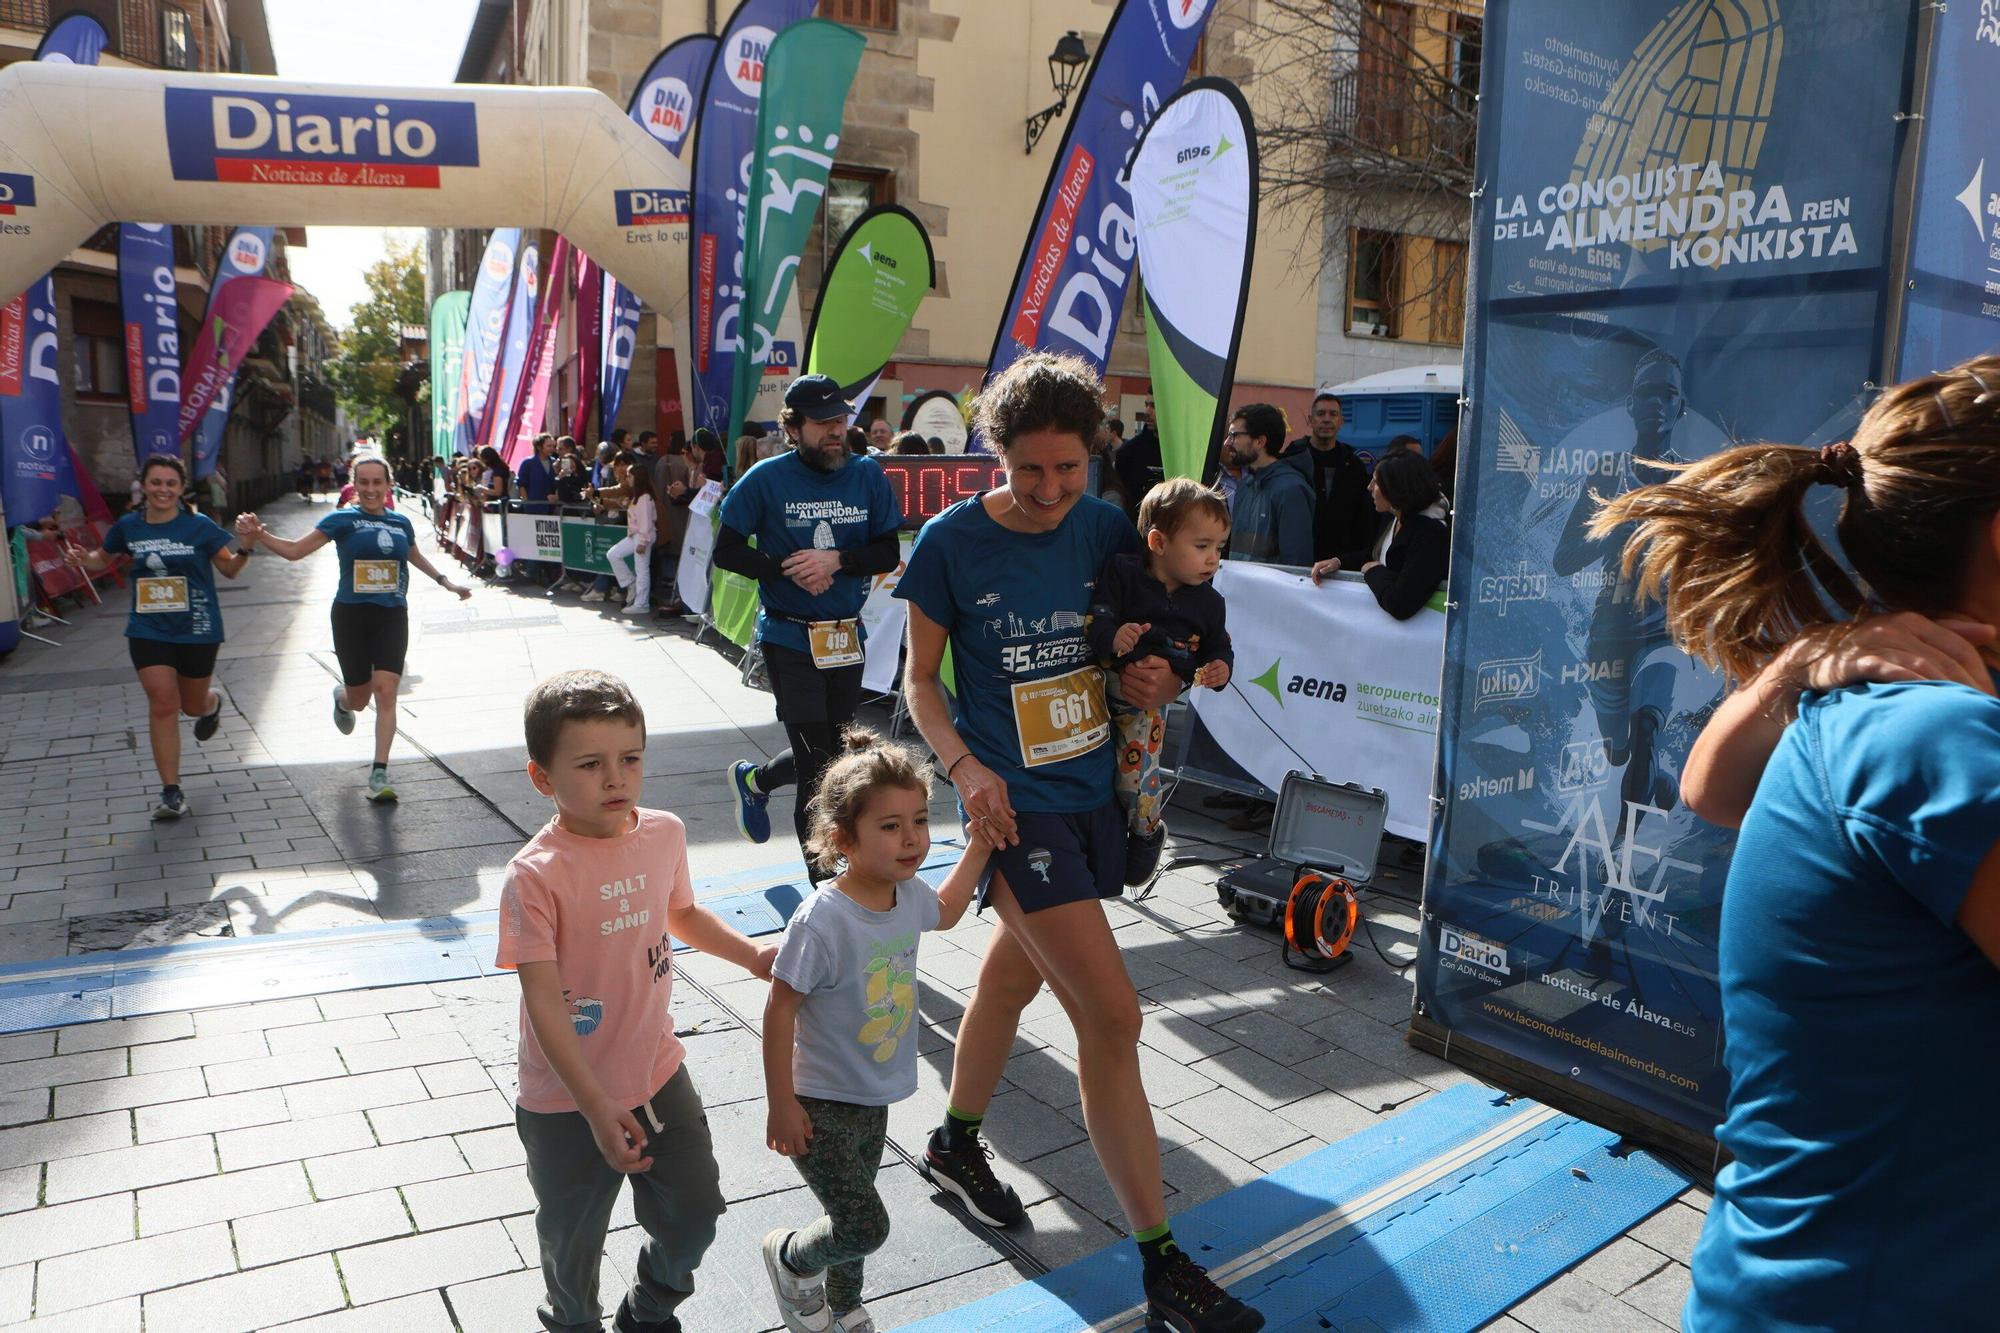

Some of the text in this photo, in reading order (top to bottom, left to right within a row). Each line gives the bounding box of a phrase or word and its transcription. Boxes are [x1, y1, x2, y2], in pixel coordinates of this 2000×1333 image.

[739, 38, 766, 59] DN
[737, 60, 763, 83] AD
[212, 95, 437, 158] Diario
[251, 163, 406, 186] Noticias de Álava
[1495, 160, 1725, 220] LA CONQUISTA
[1493, 185, 1851, 251] DE LA ALMENDRA REN
[626, 230, 653, 244] Eres
[657, 229, 668, 242] lo
[1022, 156, 1091, 326] Noticias de Álava
[1669, 222, 1859, 270] KONKISTA
[873, 251, 897, 269] aena
[144, 266, 181, 402] Diario
[796, 500, 843, 510] CONQUISTA
[799, 506, 860, 520] ALMENDRA
[831, 514, 868, 525] KONKISTA
[825, 631, 849, 650] 419
[1036, 656, 1068, 669] CROSS
[1287, 673, 1348, 704] aena
[1356, 681, 1440, 708] aeropuertos
[1049, 689, 1092, 730] 661
[1356, 700, 1414, 723] zuretzako
[1550, 791, 1670, 902] AE
[600, 874, 647, 900] SALT
[619, 898, 630, 913] &
[1530, 874, 1680, 937] TRIEVENT
[600, 911, 649, 936] SAND
[1445, 932, 1502, 968] Diario
[1440, 957, 1502, 987] Con ADN alavés
[1541, 972, 1697, 1038] noticias de Álava.eus
[1482, 1000, 1700, 1093] www.laconquistadelaalmendra.com
